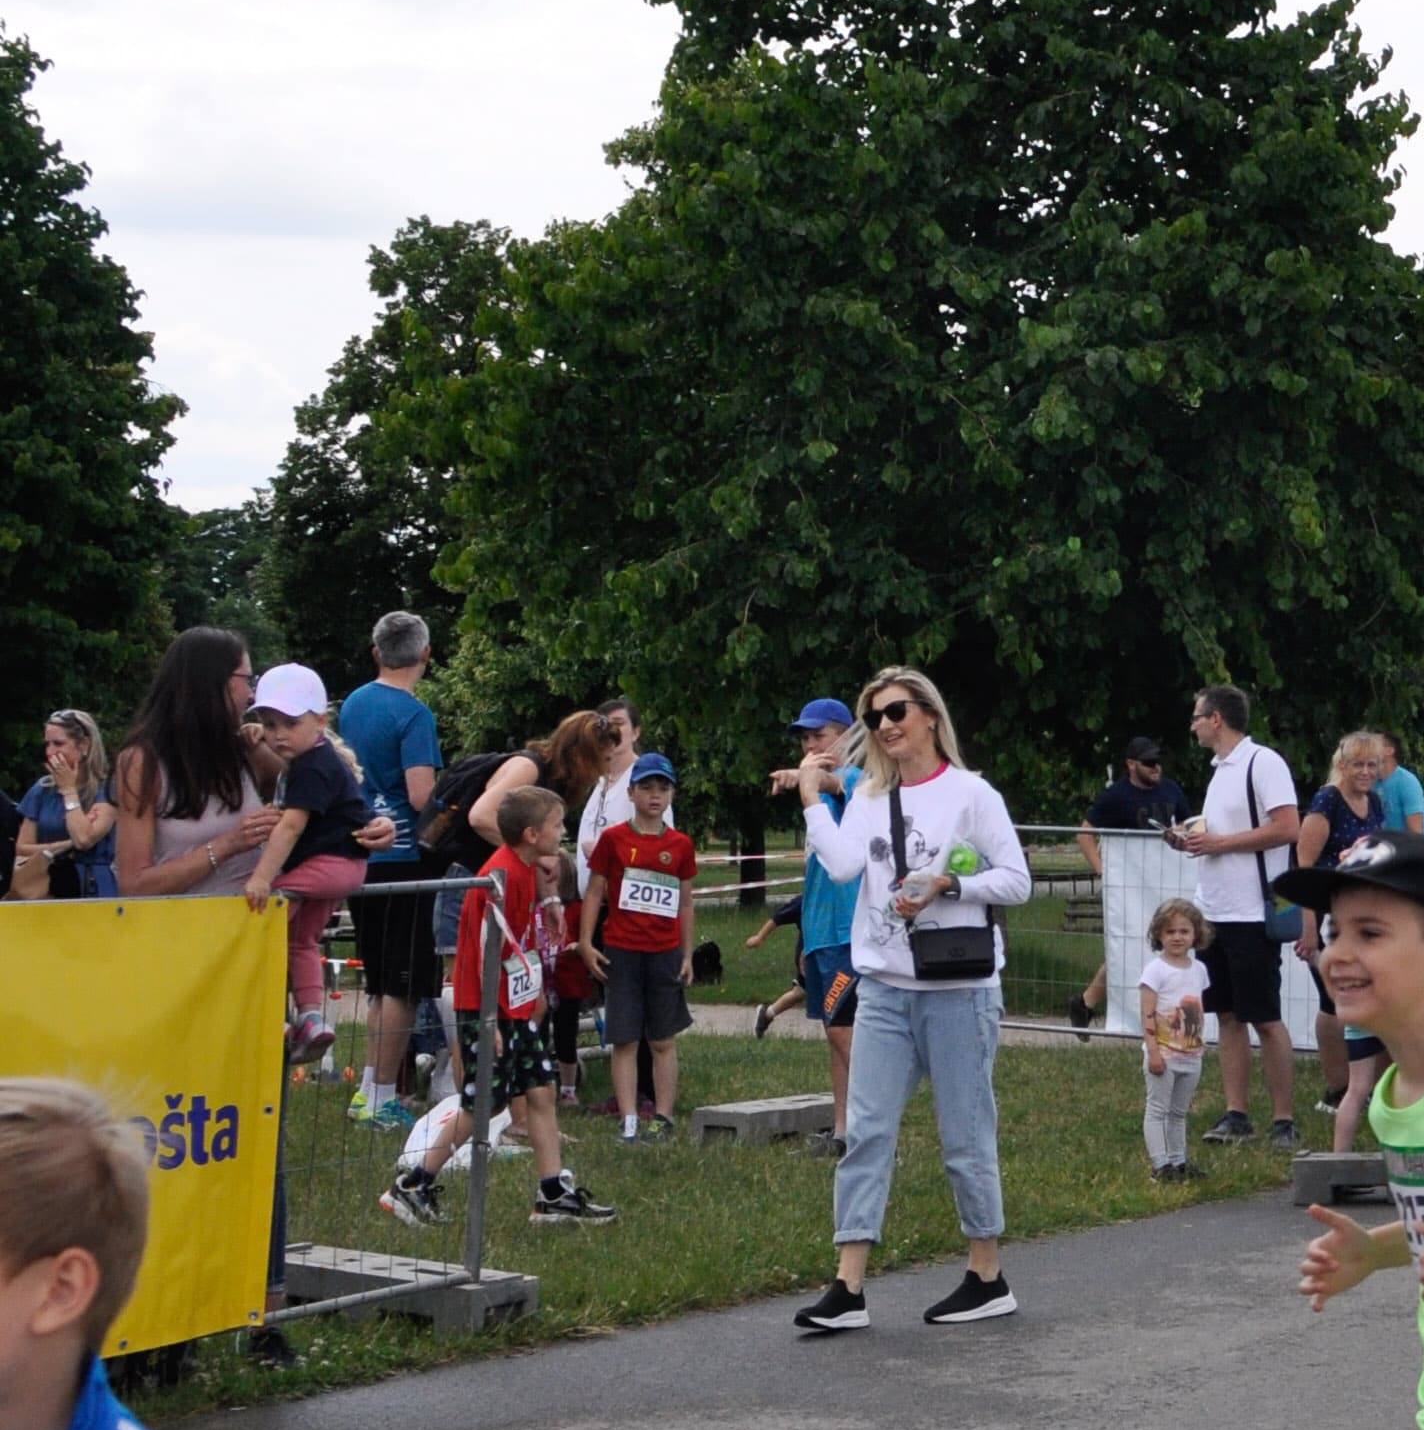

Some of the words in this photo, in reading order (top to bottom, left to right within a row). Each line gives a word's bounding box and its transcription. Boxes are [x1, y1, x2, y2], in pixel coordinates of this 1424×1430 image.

[628, 883, 673, 907] 2012
[512, 973, 534, 996] 212
[127, 1092, 240, 1170] ošta
